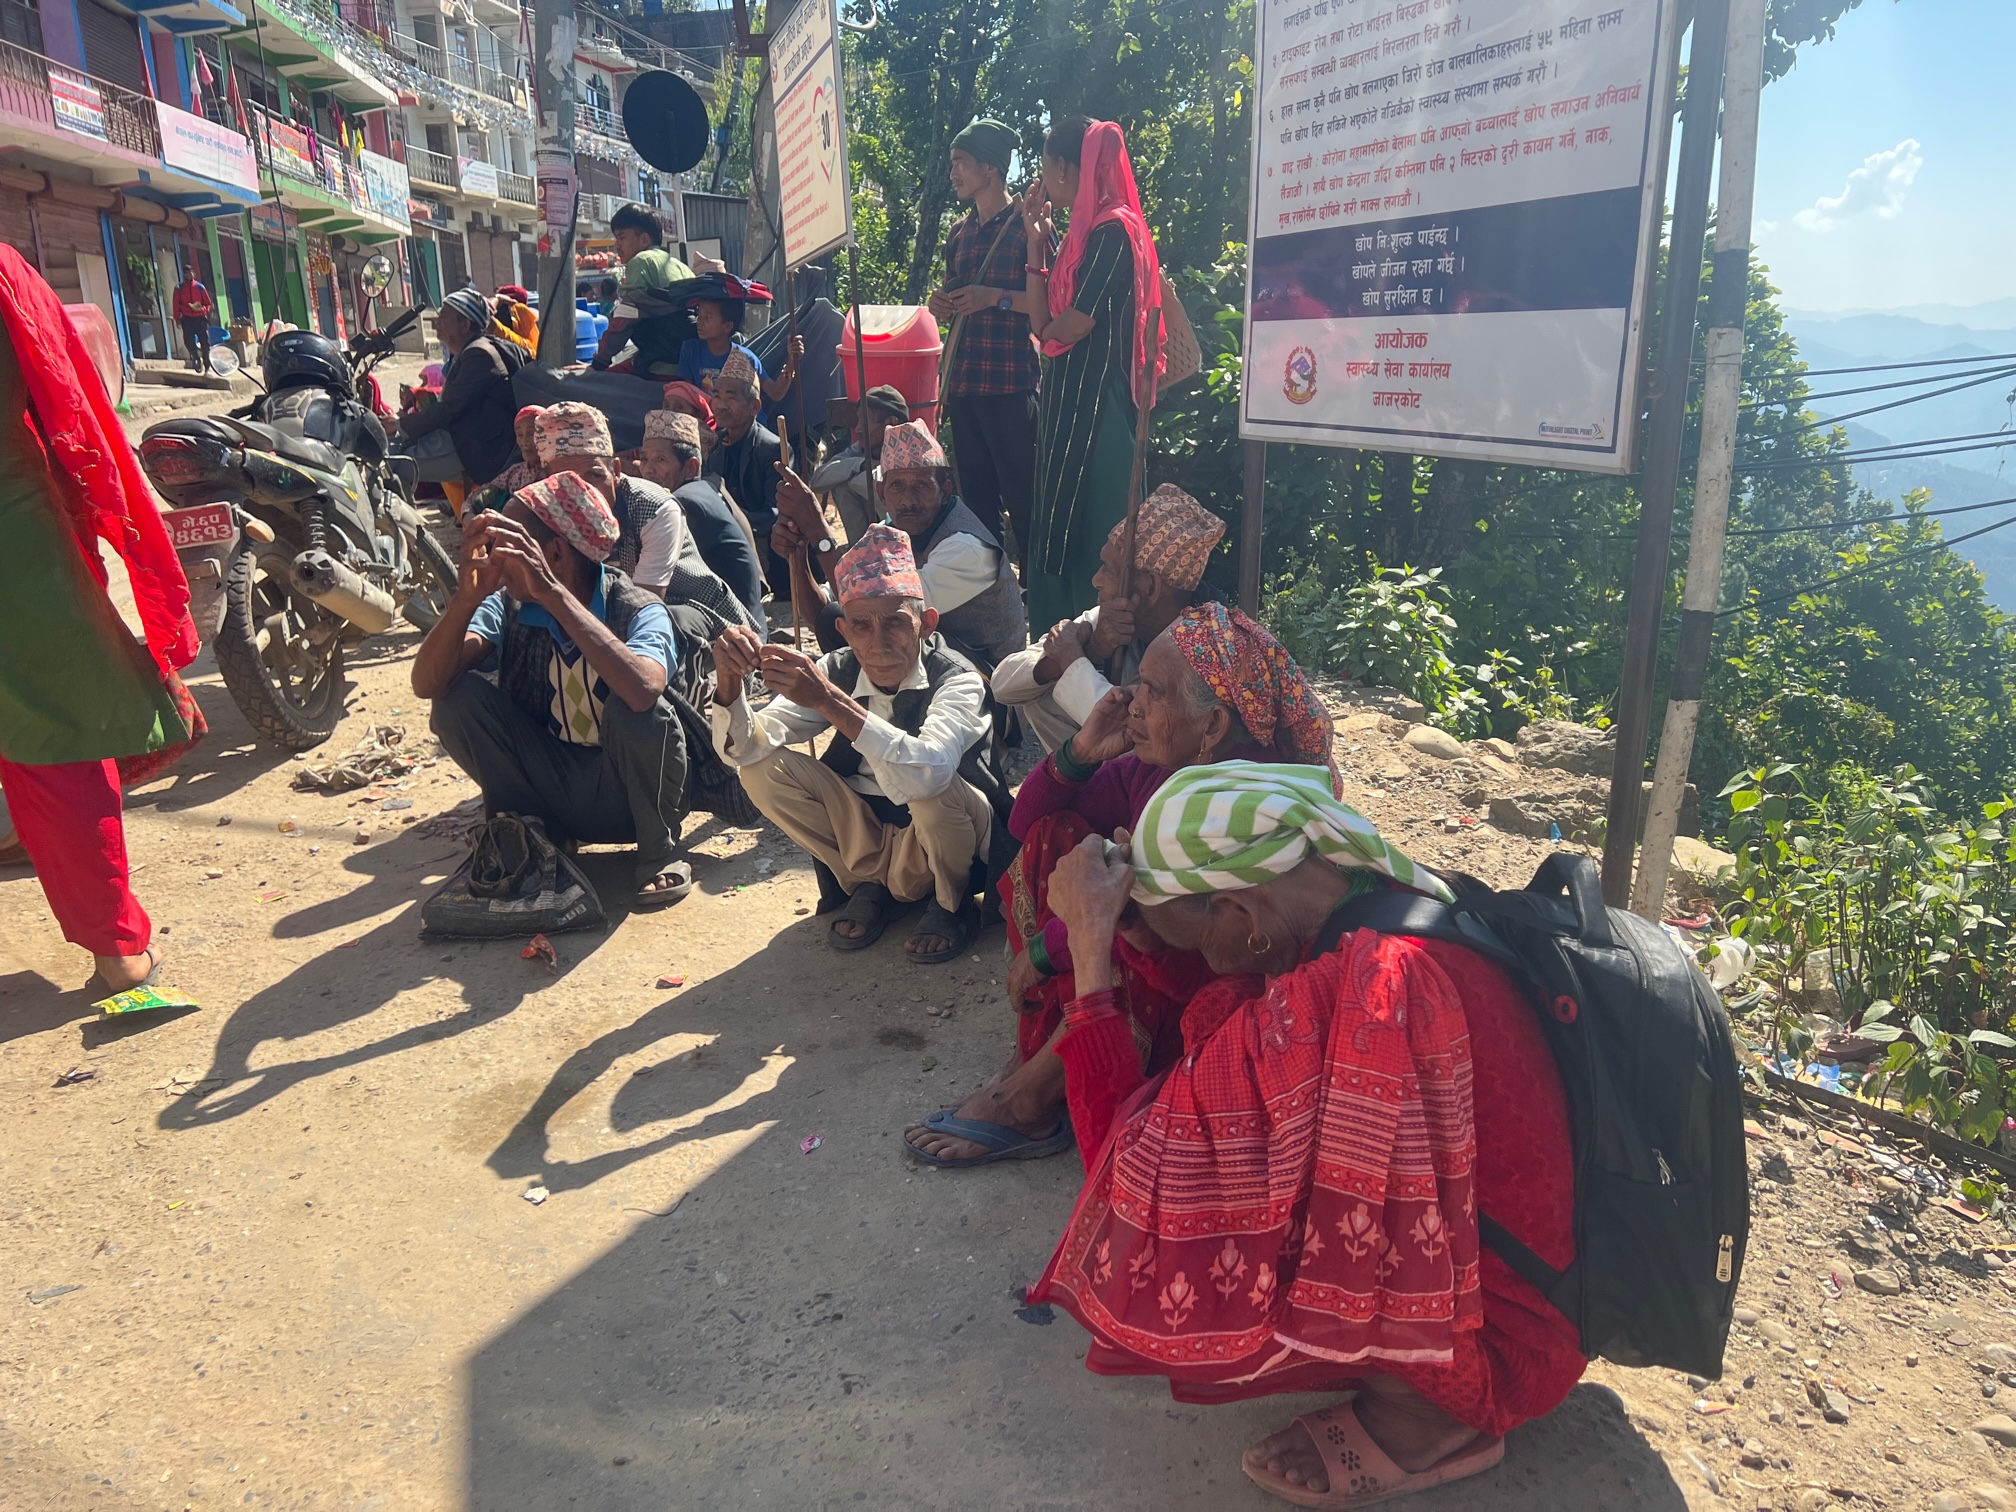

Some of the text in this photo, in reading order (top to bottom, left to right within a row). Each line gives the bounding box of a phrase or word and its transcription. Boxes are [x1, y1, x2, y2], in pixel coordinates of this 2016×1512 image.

[1314, 35, 1327, 54] रोग
[1330, 30, 1344, 47] तथा
[1348, 22, 1363, 42] रोटा
[1367, 11, 1393, 32] भाईरस
[1424, 23, 1440, 44] दिने
[1281, 103, 1293, 120] हाल
[1296, 98, 1310, 114] सम्म
[1328, 86, 1341, 104] पनि
[1344, 82, 1359, 101] खोप
[1362, 72, 1398, 95] नलगाएका
[1402, 63, 1422, 85] जिरो
[1425, 58, 1444, 79] डोज
[1559, 16, 1593, 40] महिना
[1597, 8, 1624, 32] सम्म
[1280, 129, 1292, 145] पनि
[1295, 124, 1308, 140] खोप
[1311, 120, 1323, 138] दिन
[1349, 106, 1378, 130] भएकोले
[1454, 80, 1489, 104] संस्थामा
[1493, 66, 1523, 92] सम्पर्क
[1526, 59, 1549, 85] गरौं
[1281, 160, 1294, 175] याद
[1321, 148, 1346, 167] कोरोना
[1349, 138, 1389, 162] महामारीको
[1420, 124, 1437, 144] पनि
[1524, 102, 1546, 124] खोप
[1550, 95, 1591, 119] लगाउन
[1595, 78, 1642, 109] अनिवार्य
[1329, 175, 1343, 191] खोप
[1429, 152, 1446, 172] पनि
[1460, 144, 1497, 167] मिटरको
[1501, 138, 1519, 165] दुरी
[1523, 136, 1554, 156] कायम
[1585, 126, 1613, 146] नाक,
[1343, 197, 1357, 218] गरी
[1355, 233, 1373, 252] खोप
[1351, 261, 1377, 280] खोपले
[1411, 258, 1433, 278] रक्षा
[1362, 287, 1381, 306] खोप
[1383, 284, 1418, 311] सुरक्षित
[1422, 288, 1433, 305] छ
[1374, 327, 1429, 350] आयोजक
[1345, 357, 1452, 381] स्वास्थ्य सेवा कार्यालय
[1372, 388, 1422, 411] जाजरकोट
[176, 524, 231, 543] ४६१३
